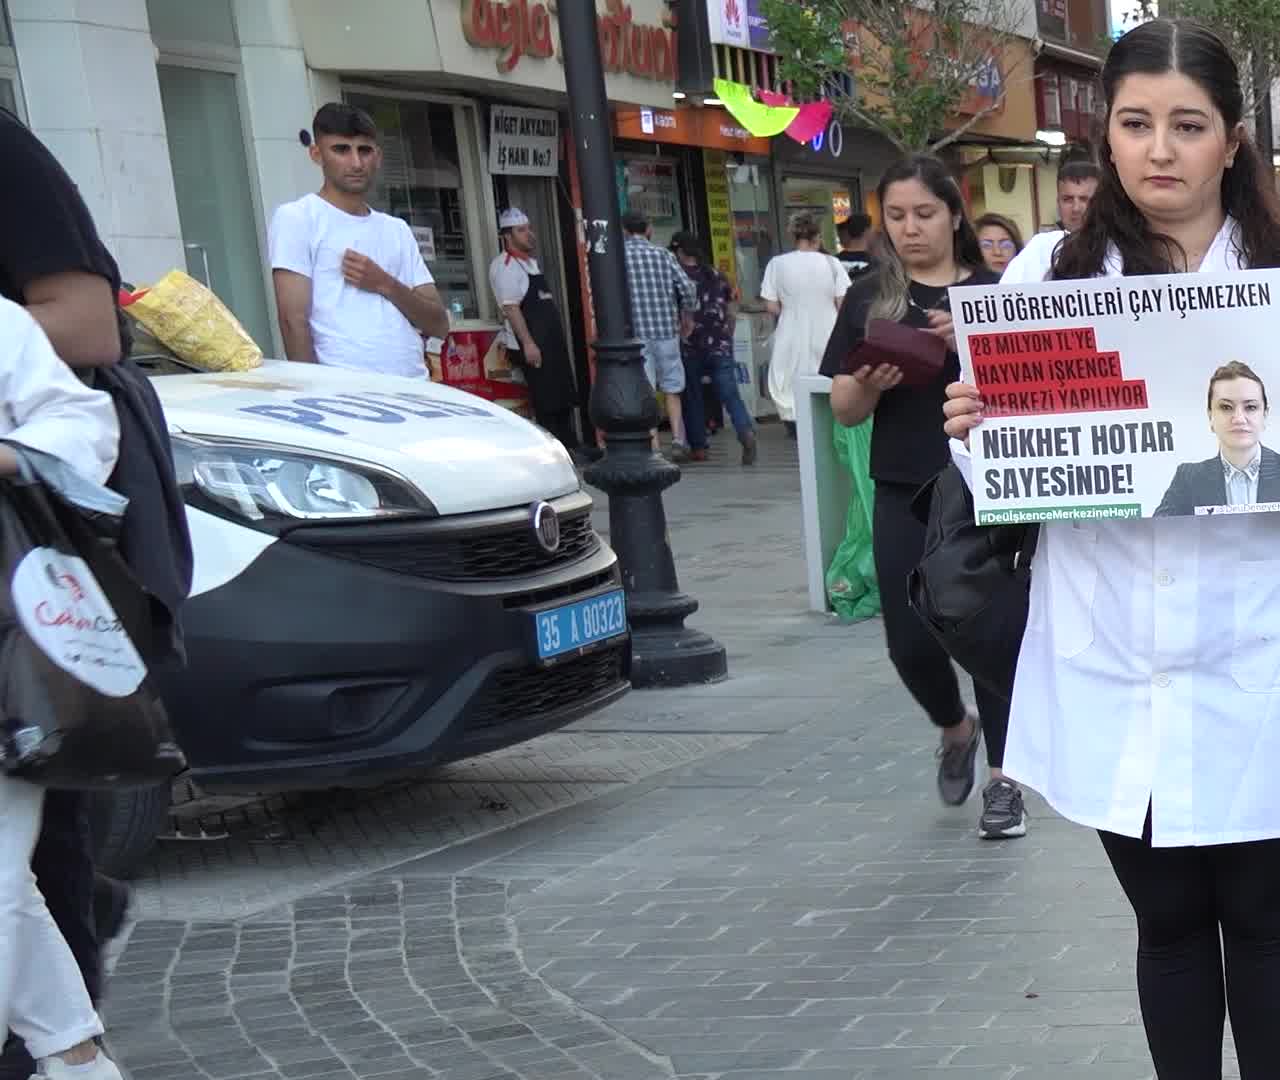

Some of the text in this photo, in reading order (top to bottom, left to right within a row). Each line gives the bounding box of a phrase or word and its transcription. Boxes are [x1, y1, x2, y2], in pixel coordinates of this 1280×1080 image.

[961, 282, 1271, 325] DEÜ ÖĞRENCİLERİ ÇAY İÇEMEZKEN
[971, 328, 1094, 357] 28 MİLYON TL'YE
[976, 356, 1119, 387] HAYVAN İŞKENCE
[980, 384, 1145, 415] MERKEZİ YAPILIYOR
[982, 421, 1175, 460] NÜKHET HOTAR
[985, 464, 1135, 500] SAYESİNDE!
[541, 596, 624, 651] 35 A 80323
